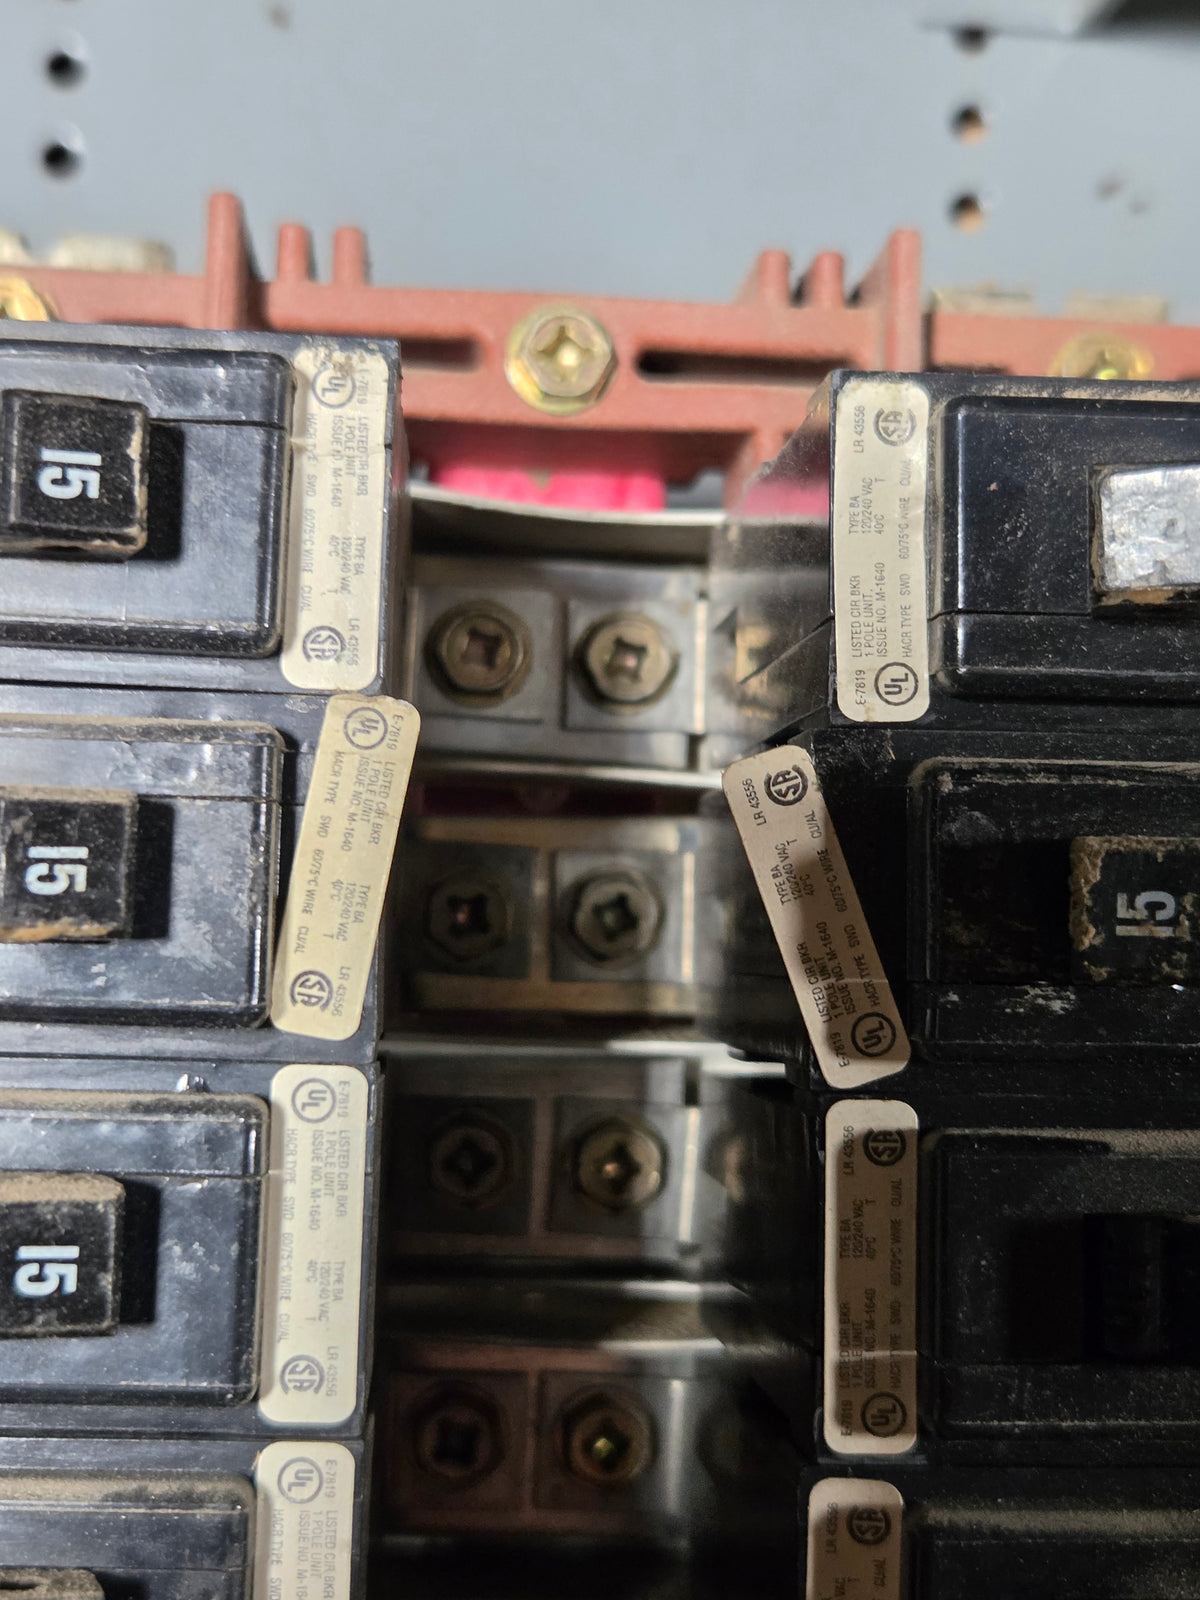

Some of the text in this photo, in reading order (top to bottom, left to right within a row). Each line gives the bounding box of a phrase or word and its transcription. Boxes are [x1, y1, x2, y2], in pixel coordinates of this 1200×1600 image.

[853, 405, 865, 453] LR 43556
[38, 448, 101, 500] 15
[848, 511, 859, 534] TYPE
[861, 477, 873, 533] 120/240 VAC
[874, 562, 885, 601] M-1640
[899, 573, 910, 596] SWD
[849, 575, 862, 657] LISTED CIR BKR
[863, 621, 874, 648] POLE
[900, 604, 912, 658] HACR TYPE
[876, 627, 887, 657] ISSUE
[855, 669, 866, 705] E-7819
[386, 714, 404, 750] E-7819
[324, 750, 346, 804] HACR TYPE
[353, 755, 370, 788] ISSUE
[365, 768, 380, 794] POLE
[360, 798, 374, 823] UNIT
[368, 761, 395, 844] LISTED CIR BKR
[742, 778, 766, 826] LR 43556
[317, 815, 331, 838] SWD
[341, 812, 358, 851] M-1640
[23, 845, 89, 896] 15
[775, 843, 802, 900] 120/240 VAC
[817, 848, 834, 874] WIRE
[301, 889, 316, 915] WIRE
[335, 882, 356, 941] 120/240 VAC
[355, 885, 371, 908] TYPE
[774, 880, 790, 905] TYPE
[1116, 891, 1176, 937] 15
[816, 921, 837, 961] M-1640
[843, 924, 860, 948] SWD
[797, 942, 832, 1023] LISTED CIR BKR
[813, 957, 831, 981] UNIT
[853, 953, 880, 1007] HACR TYPE
[331, 966, 351, 1016] LR 43556
[823, 982, 841, 1010] POLE
[837, 983, 856, 1015] ISSUE
[830, 1032, 850, 1068] E-7819
[337, 1080, 350, 1118] E-7819
[285, 1128, 298, 1184] HACR TYPE
[311, 1129, 323, 1162] ISSUE
[323, 1139, 337, 1197] POLE UNIT
[336, 1129, 350, 1217] LISTED CIR BKR
[309, 1188, 322, 1230] M-1640
[14, 1245, 80, 1297] 15
[279, 1274, 292, 1301] WIRE
[333, 1260, 345, 1285] TYPE
[317, 1261, 331, 1322] 120/240 VAC
[325, 1345, 338, 1397] LR 43556
[324, 1459, 337, 1498] E-7819
[271, 1508, 284, 1565] HACR TYPE
[297, 1510, 310, 1542] ISSUE
[310, 1519, 323, 1579] POLE UNIT
[323, 1510, 337, 1598] LISTED CIR BKR
[296, 1568, 308, 1599] M-16
